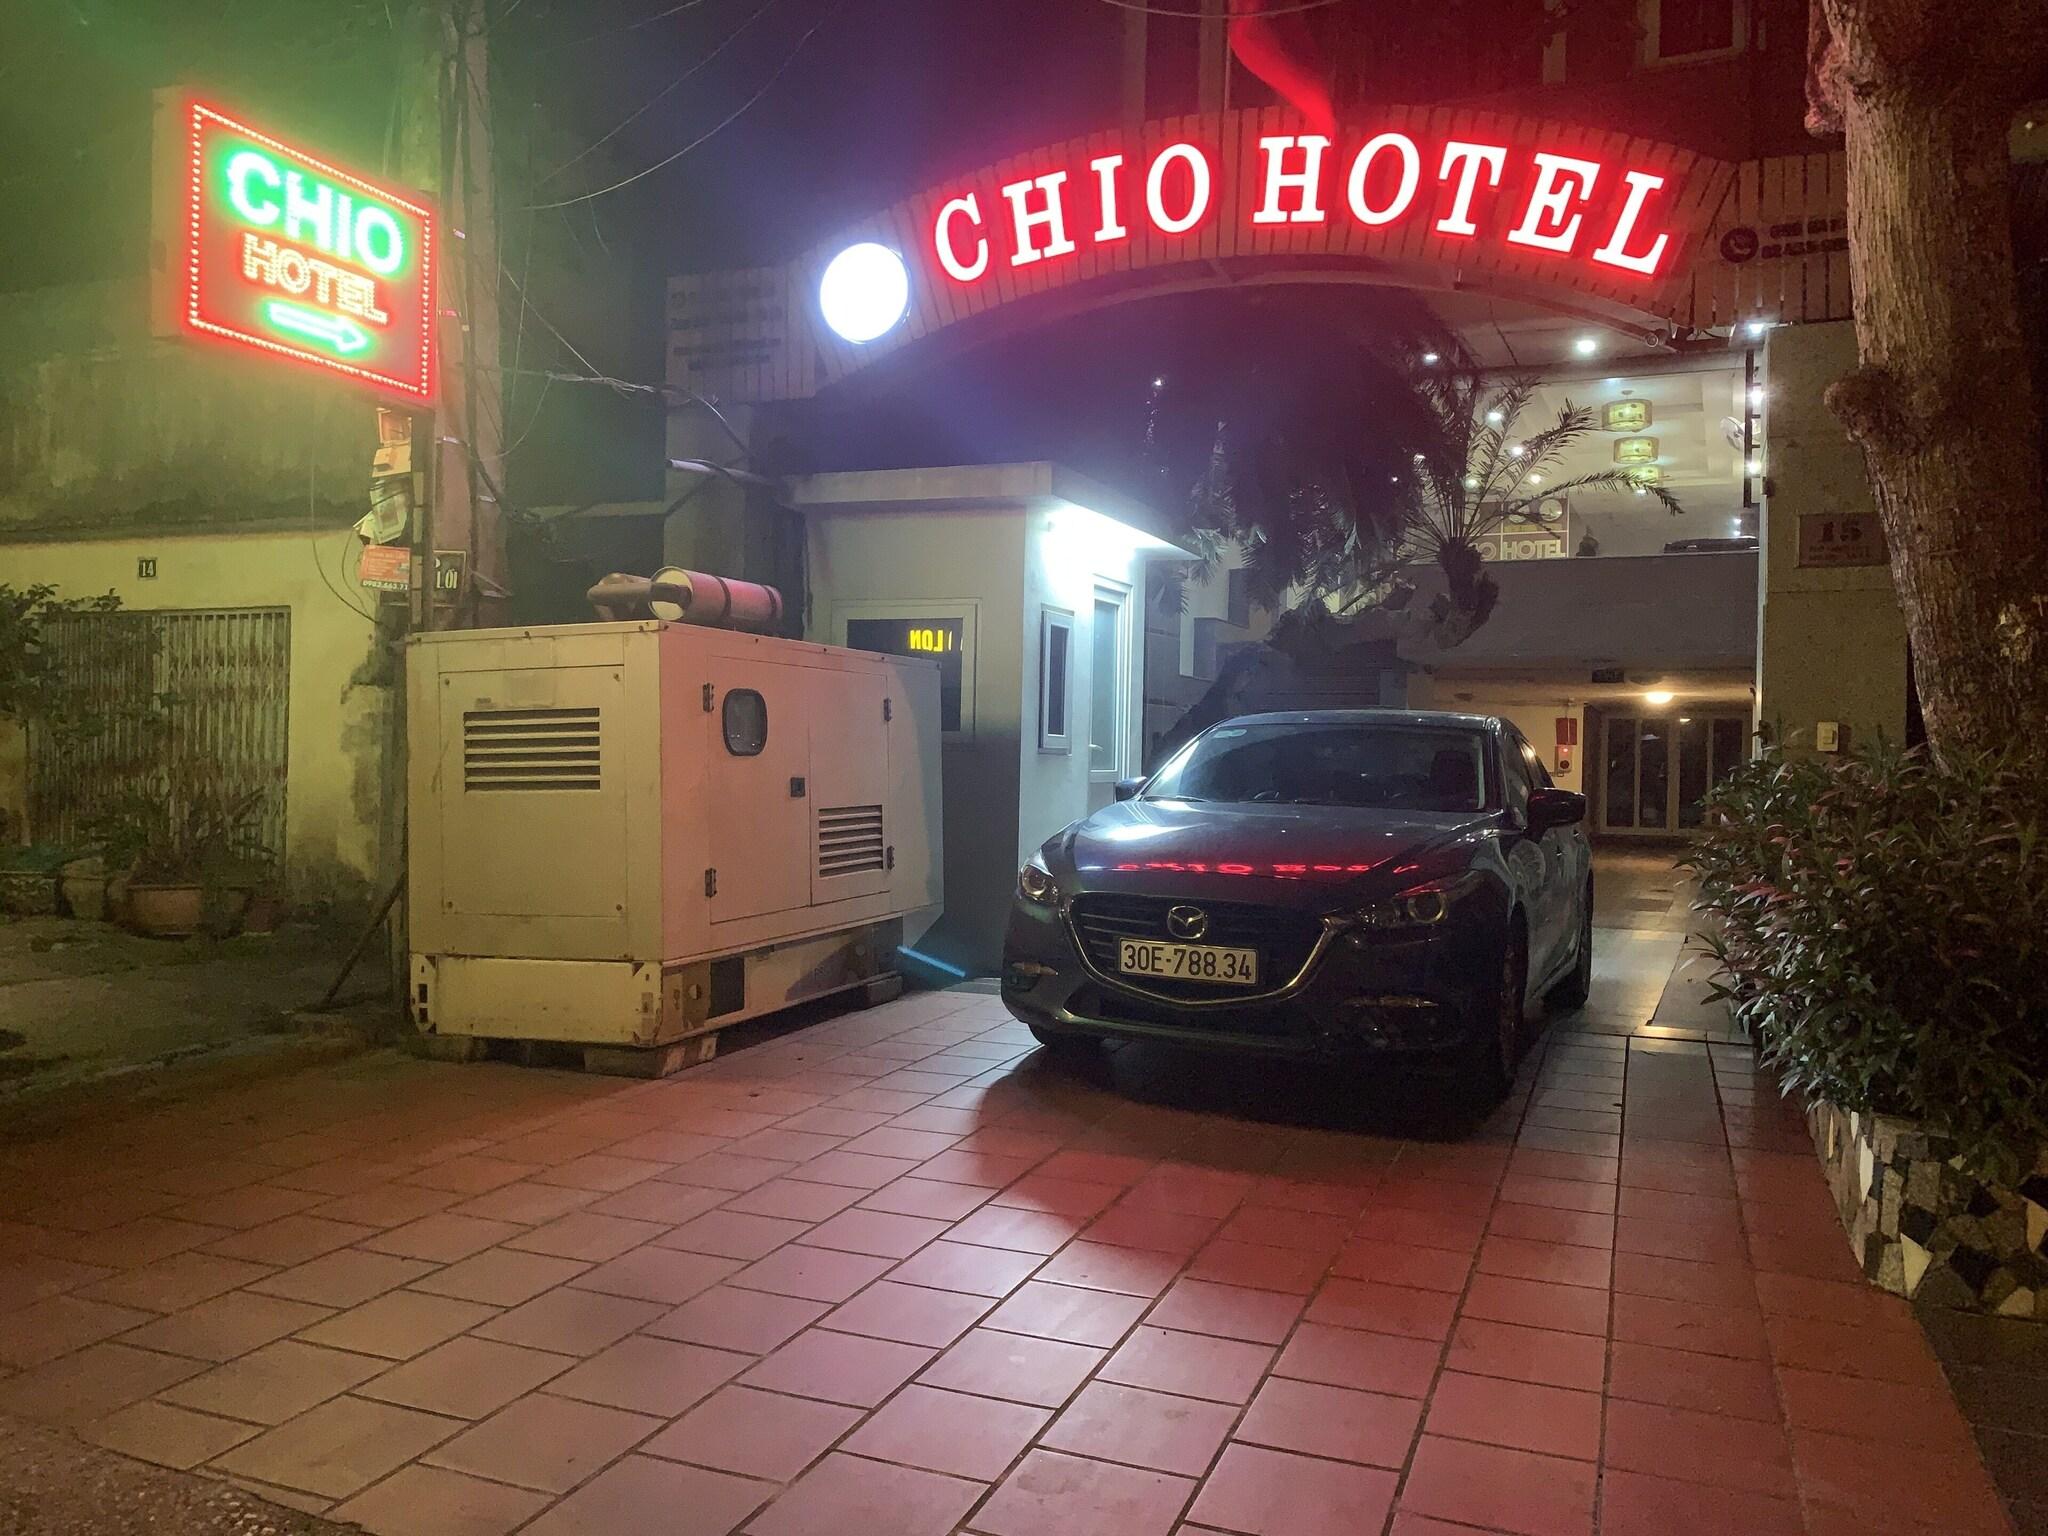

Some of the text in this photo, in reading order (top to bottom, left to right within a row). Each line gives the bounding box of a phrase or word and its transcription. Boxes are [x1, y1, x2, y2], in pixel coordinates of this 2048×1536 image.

[227, 151, 404, 274] CHIO
[933, 132, 1670, 281] CHIO HOTEL
[241, 231, 388, 325] HOTEL
[1503, 539, 1567, 560] HOTEL
[1817, 520, 1863, 542] 15
[142, 561, 154, 576] 14
[1123, 944, 1252, 981] 30E-788.34
